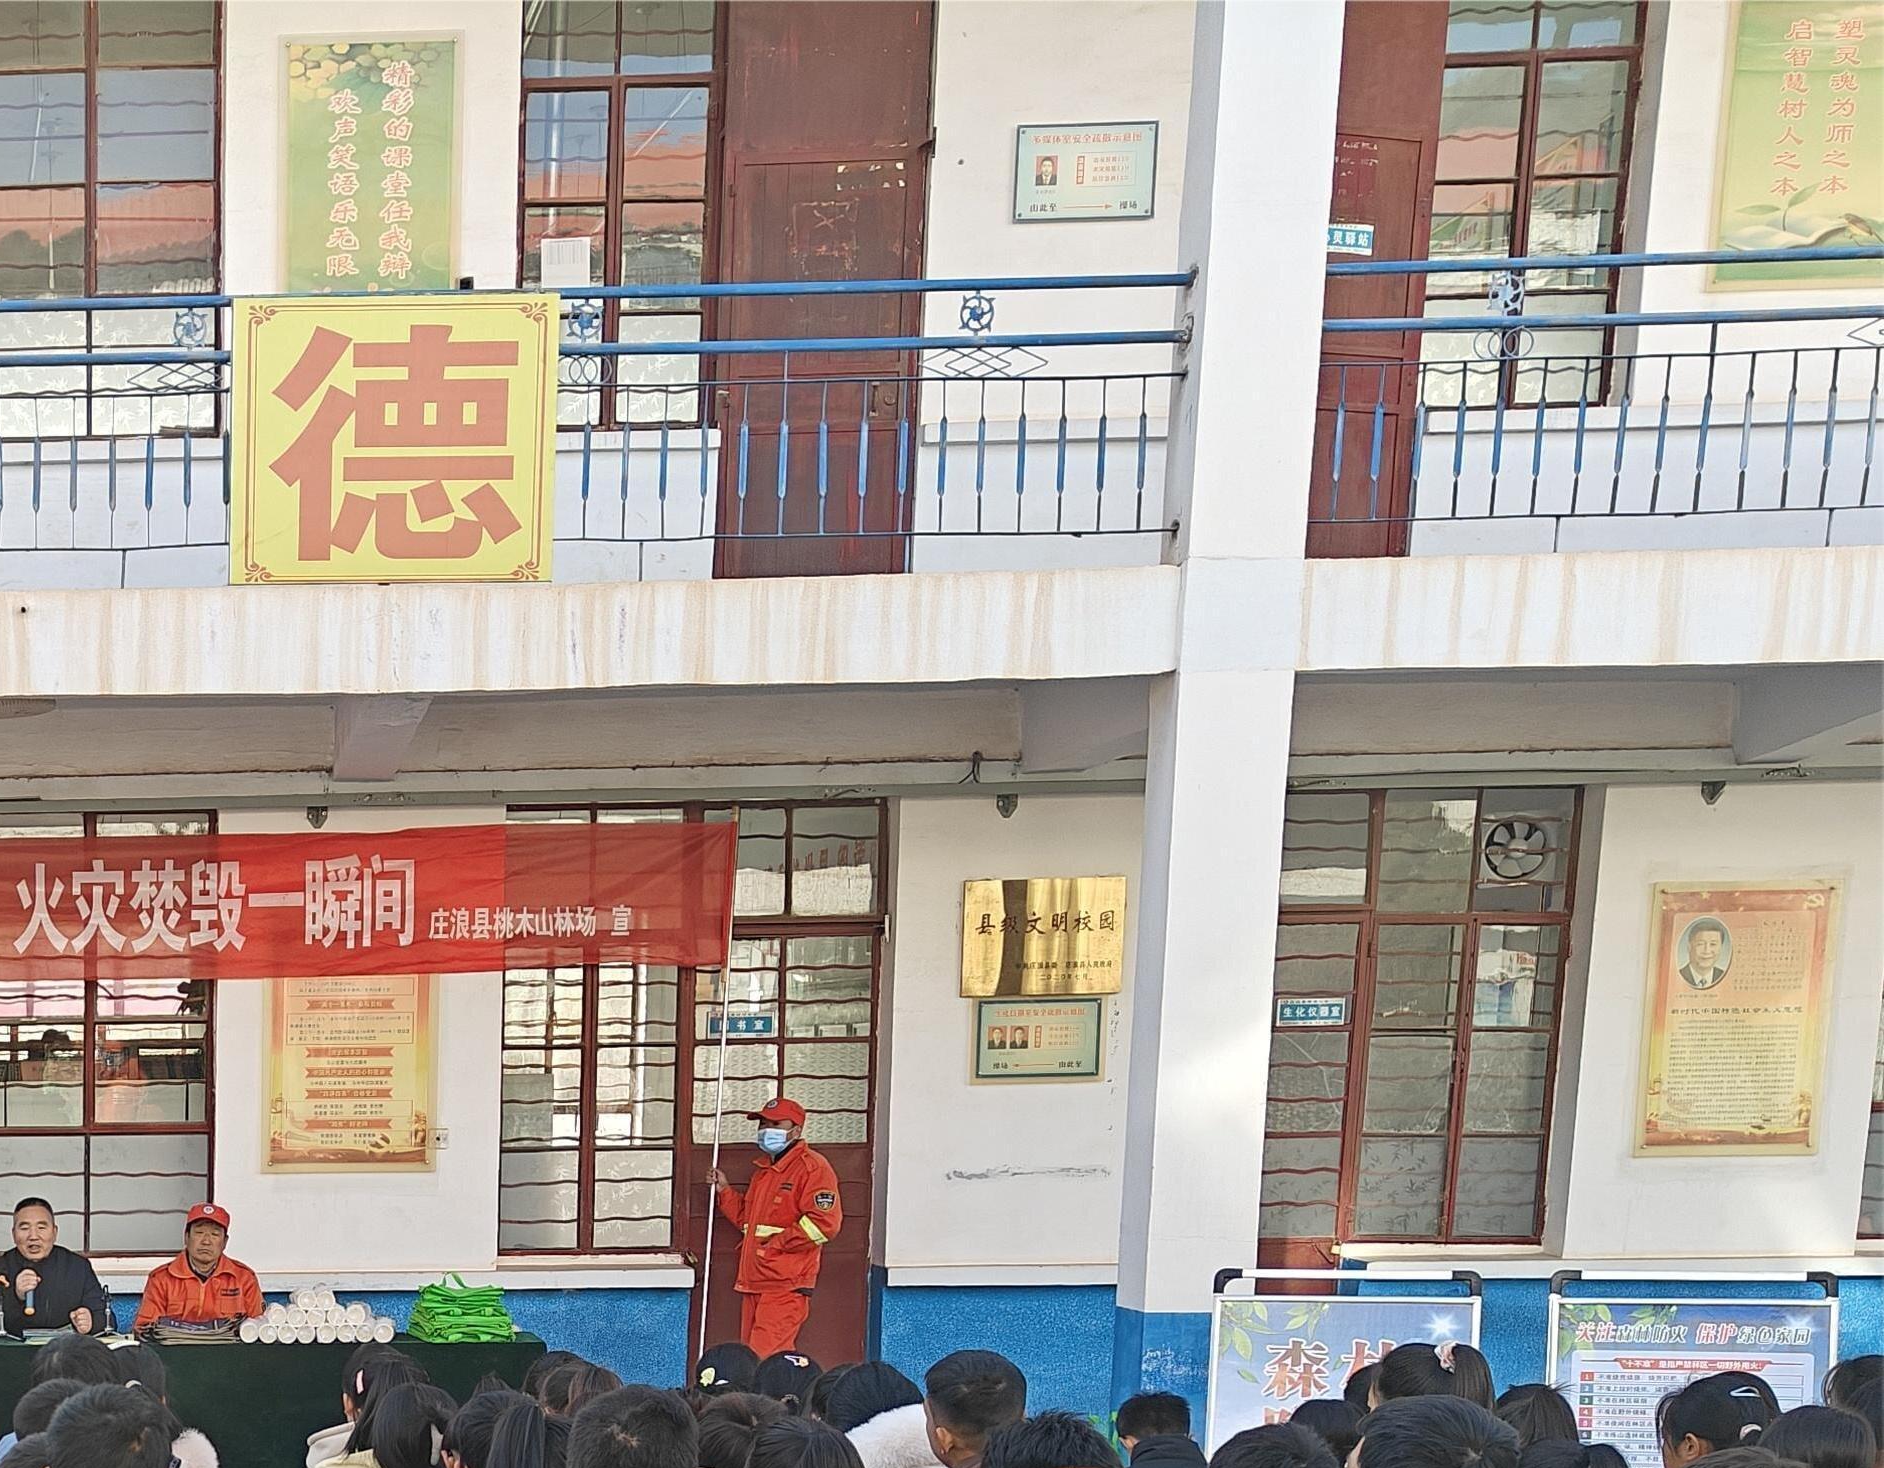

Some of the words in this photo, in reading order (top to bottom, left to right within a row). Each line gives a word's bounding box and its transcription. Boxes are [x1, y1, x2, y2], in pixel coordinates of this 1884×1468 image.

[326, 88, 362, 277] 欢声笑语乐无限
[1770, 18, 1814, 197] 启智慧树人之本
[1819, 18, 1865, 195] 塑灵魂为师之本
[268, 324, 522, 561] 德
[13, 853, 416, 957] 火灾焚毁一瞬间
[427, 903, 597, 942] 庄浪县桃木山林场
[610, 903, 633, 938] 宣
[975, 909, 1116, 936] 县级文明校园
[1695, 1322, 1812, 1346] 保护绿色家园
